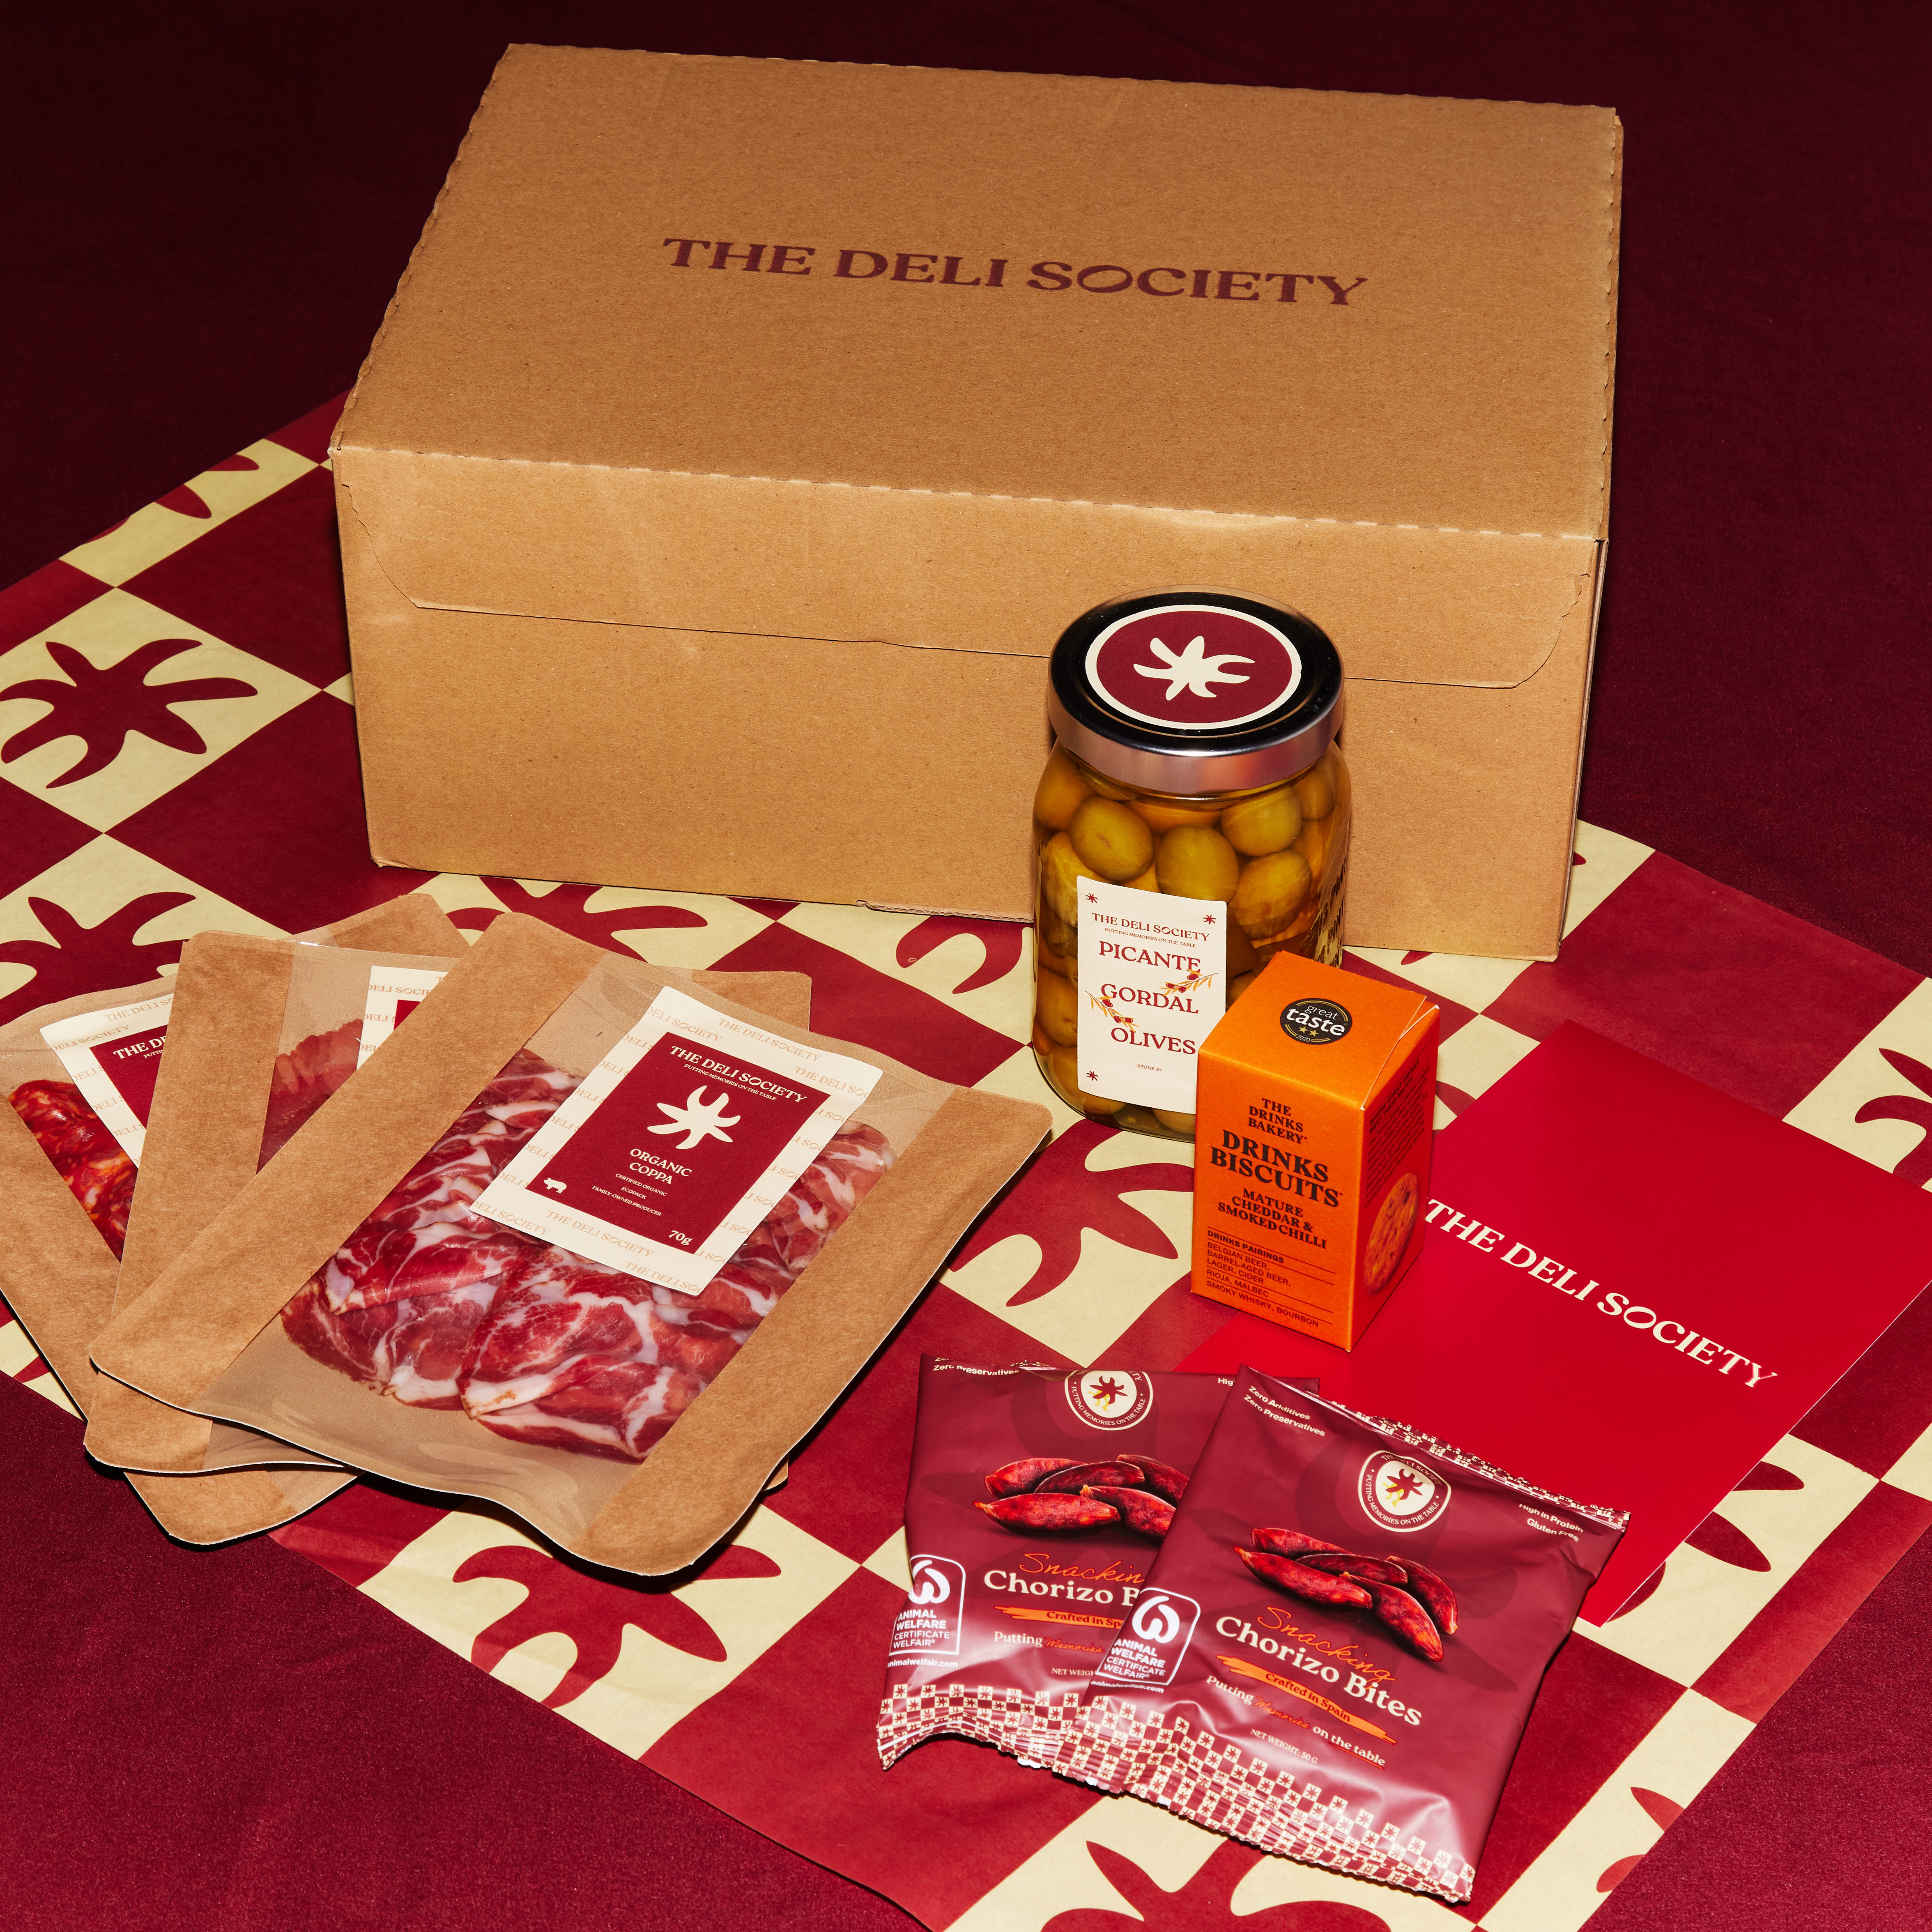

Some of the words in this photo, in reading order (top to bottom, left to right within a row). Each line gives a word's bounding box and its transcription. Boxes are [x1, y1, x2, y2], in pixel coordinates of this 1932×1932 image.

[663, 237, 815, 276] THE
[833, 249, 1009, 287] DELI
[1027, 260, 1368, 306] SOCIETY
[1092, 913, 1118, 925] THE
[1121, 919, 1150, 932] DELI
[1153, 925, 1210, 941] SOCIETY
[1105, 927, 1128, 936] PUTTING
[1129, 932, 1157, 942] MEMORIES
[1099, 941, 1201, 973] PICANTE
[104, 1007, 131, 1021] THE
[130, 1002, 159, 1016] DELI
[1101, 983, 1198, 1014] GORDAL
[1287, 1008, 1345, 1036] taste
[1304, 1006, 1338, 1020] great
[78, 1025, 130, 1044] SOCIETY
[672, 1019, 722, 1042] SOCIETY
[718, 1018, 742, 1033] THE
[744, 1027, 770, 1043] DELI
[770, 1039, 822, 1062] SOCIETY
[1111, 1028, 1196, 1055] OLIVES
[113, 1042, 149, 1060] THE
[670, 1046, 702, 1064] THE
[701, 1059, 738, 1078] DELI
[738, 1073, 807, 1103] SOCIETY
[684, 1063, 709, 1076] PUTTING
[708, 1073, 738, 1088] MEMORIES
[747, 1087, 759, 1095] THE
[759, 1092, 776, 1101] TABLE
[794, 1066, 818, 1081] THE
[819, 1074, 847, 1090] DELI
[1387, 1079, 1403, 1105] GREAT
[1249, 1105, 1304, 1132] DRINKS
[1262, 1097, 1291, 1116] THE
[630, 1149, 692, 1176] ORGANIC
[1222, 1129, 1328, 1182] DRINKS
[615, 1173, 642, 1187] CERTIFIED
[642, 1184, 667, 1196] ORGANIC
[629, 1162, 672, 1184] COPPA
[592, 1186, 632, 1204] FAMILY-OWNED
[632, 1202, 662, 1216] PRODUCER
[621, 1187, 647, 1199] ECOPACK
[1242, 1188, 1304, 1218] MATURE
[498, 1211, 551, 1235] SOCIETY
[1218, 1202, 1277, 1230] SMOKED
[1279, 1225, 1327, 1249] CHILLI
[1232, 1196, 1300, 1228] CHEDDAR
[1303, 1222, 1313, 1233] &
[548, 1210, 571, 1225] THE
[573, 1220, 601, 1238] DELI
[601, 1233, 655, 1258] SOCIETY
[669, 1230, 692, 1246] 70g
[1208, 1230, 1240, 1247] DRINKS
[1242, 1243, 1284, 1263] PAIRINGS
[1208, 1242, 1243, 1260] BELGIAN
[1245, 1256, 1270, 1271] BEER,
[1208, 1250, 1264, 1276] BARREL-AGED
[1267, 1272, 1291, 1287] BEER,
[625, 1261, 650, 1276] THE
[650, 1270, 679, 1287] DELI
[1207, 1258, 1236, 1274] LAGER,
[1239, 1270, 1264, 1284] CIDER
[1235, 1280, 1269, 1297] MALBEC
[1425, 1199, 1505, 1253] THE
[1501, 1242, 1599, 1301] DELI
[1597, 1292, 1778, 1388] SOCIETY
[1207, 1281, 1236, 1296] SMOKY
[1277, 1307, 1318, 1327] BOURBON
[956, 1365, 1019, 1375] Preservatives
[1218, 1378, 1235, 1386] Hig
[1071, 1387, 1085, 1410] PUTTING
[1083, 1410, 1116, 1425] MEMORIES
[1134, 1398, 1146, 1414] TABLE
[1244, 1395, 1263, 1411] Zero
[1263, 1409, 1325, 1436] Preservatives
[1249, 1386, 1268, 1402] Zero
[1268, 1399, 1311, 1420] Additives
[1416, 1465, 1442, 1486] SOCIETY
[1365, 1475, 1373, 1502] PUTTING
[1369, 1502, 1399, 1525] MEMORIES
[1411, 1514, 1425, 1523] THE
[1423, 1502, 1439, 1517] TABLE
[1519, 1504, 1540, 1515] High
[1550, 1516, 1583, 1533] Protein
[1527, 1518, 1557, 1535] Gluten
[1558, 1531, 1579, 1542] Free
[1019, 1553, 1145, 1584] Snackin
[984, 1570, 1113, 1604] Chorizo
[897, 1620, 946, 1631] WELFARE
[898, 1610, 936, 1622] ANIMAL
[1046, 1611, 1089, 1623] Crafted
[895, 1631, 950, 1640] CERTIFICATE
[994, 1631, 1042, 1648] Putting
[1044, 1637, 1104, 1653] Memories
[1114, 1639, 1157, 1657] ANIMAL
[1257, 1606, 1397, 1690] Snacking
[1106, 1656, 1166, 1676] CERTIFICATE
[1111, 1647, 1166, 1668] WELFARE
[1216, 1616, 1339, 1683] Chorizo
[1343, 1672, 1422, 1726] Bites
[1090, 1680, 1164, 1693] animalwelfair.com
[1265, 1673, 1307, 1697] Crafted
[1308, 1691, 1319, 1704] in
[1320, 1699, 1350, 1723] Spain
[1205, 1675, 1254, 1706] Putting
[1254, 1695, 1311, 1729] Memories
[1313, 1726, 1329, 1739] on
[1330, 1734, 1352, 1750] the
[1353, 1746, 1386, 1766] table
[1251, 1728, 1267, 1739] NET
[1267, 1734, 1301, 1756] WEIGHT:
[1301, 1750, 1311, 1761] 50
[1311, 1756, 1318, 1764] G
